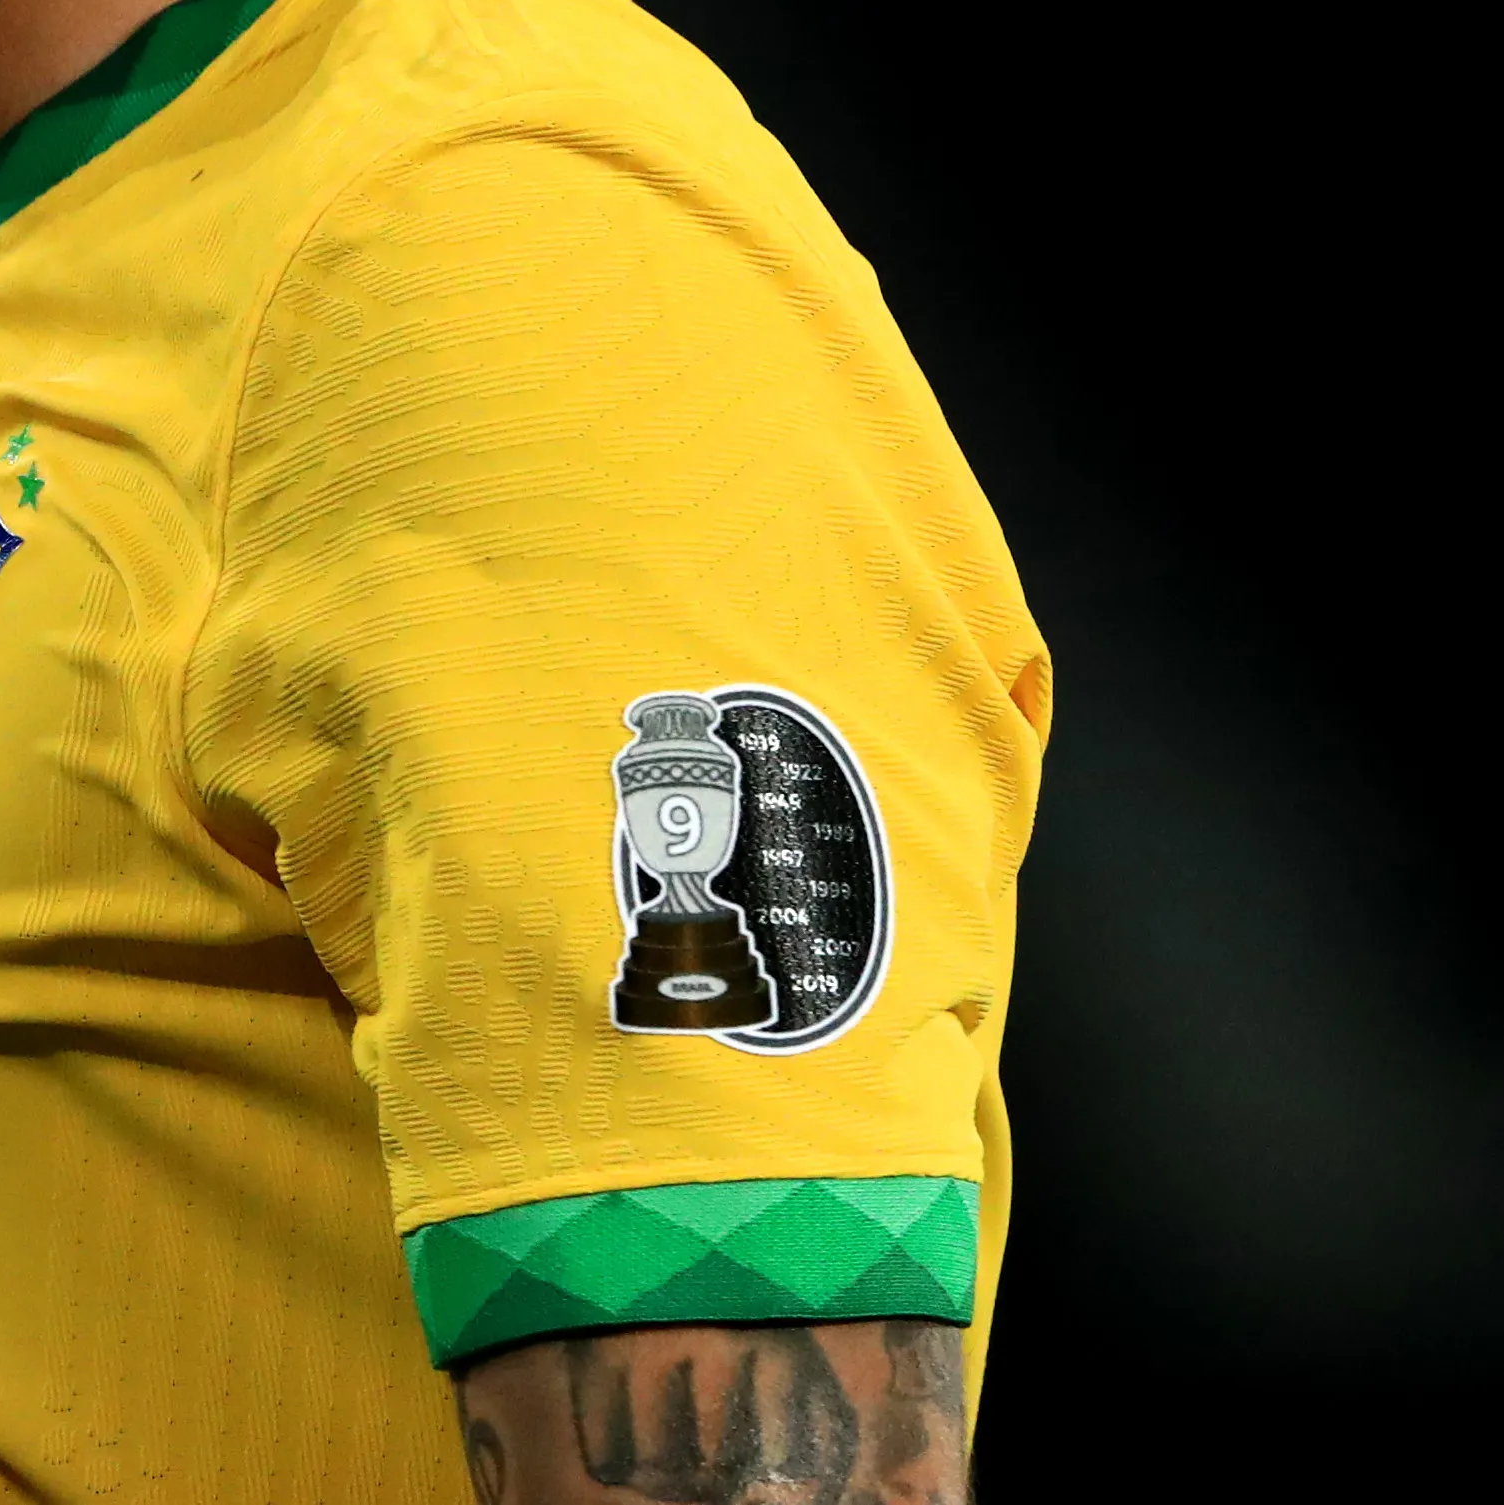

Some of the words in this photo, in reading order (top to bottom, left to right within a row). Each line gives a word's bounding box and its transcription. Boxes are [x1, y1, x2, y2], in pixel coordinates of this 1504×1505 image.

[780, 761, 824, 781] 1922
[658, 794, 702, 857] 9
[754, 907, 811, 926] 2004
[790, 974, 840, 993] 2019
